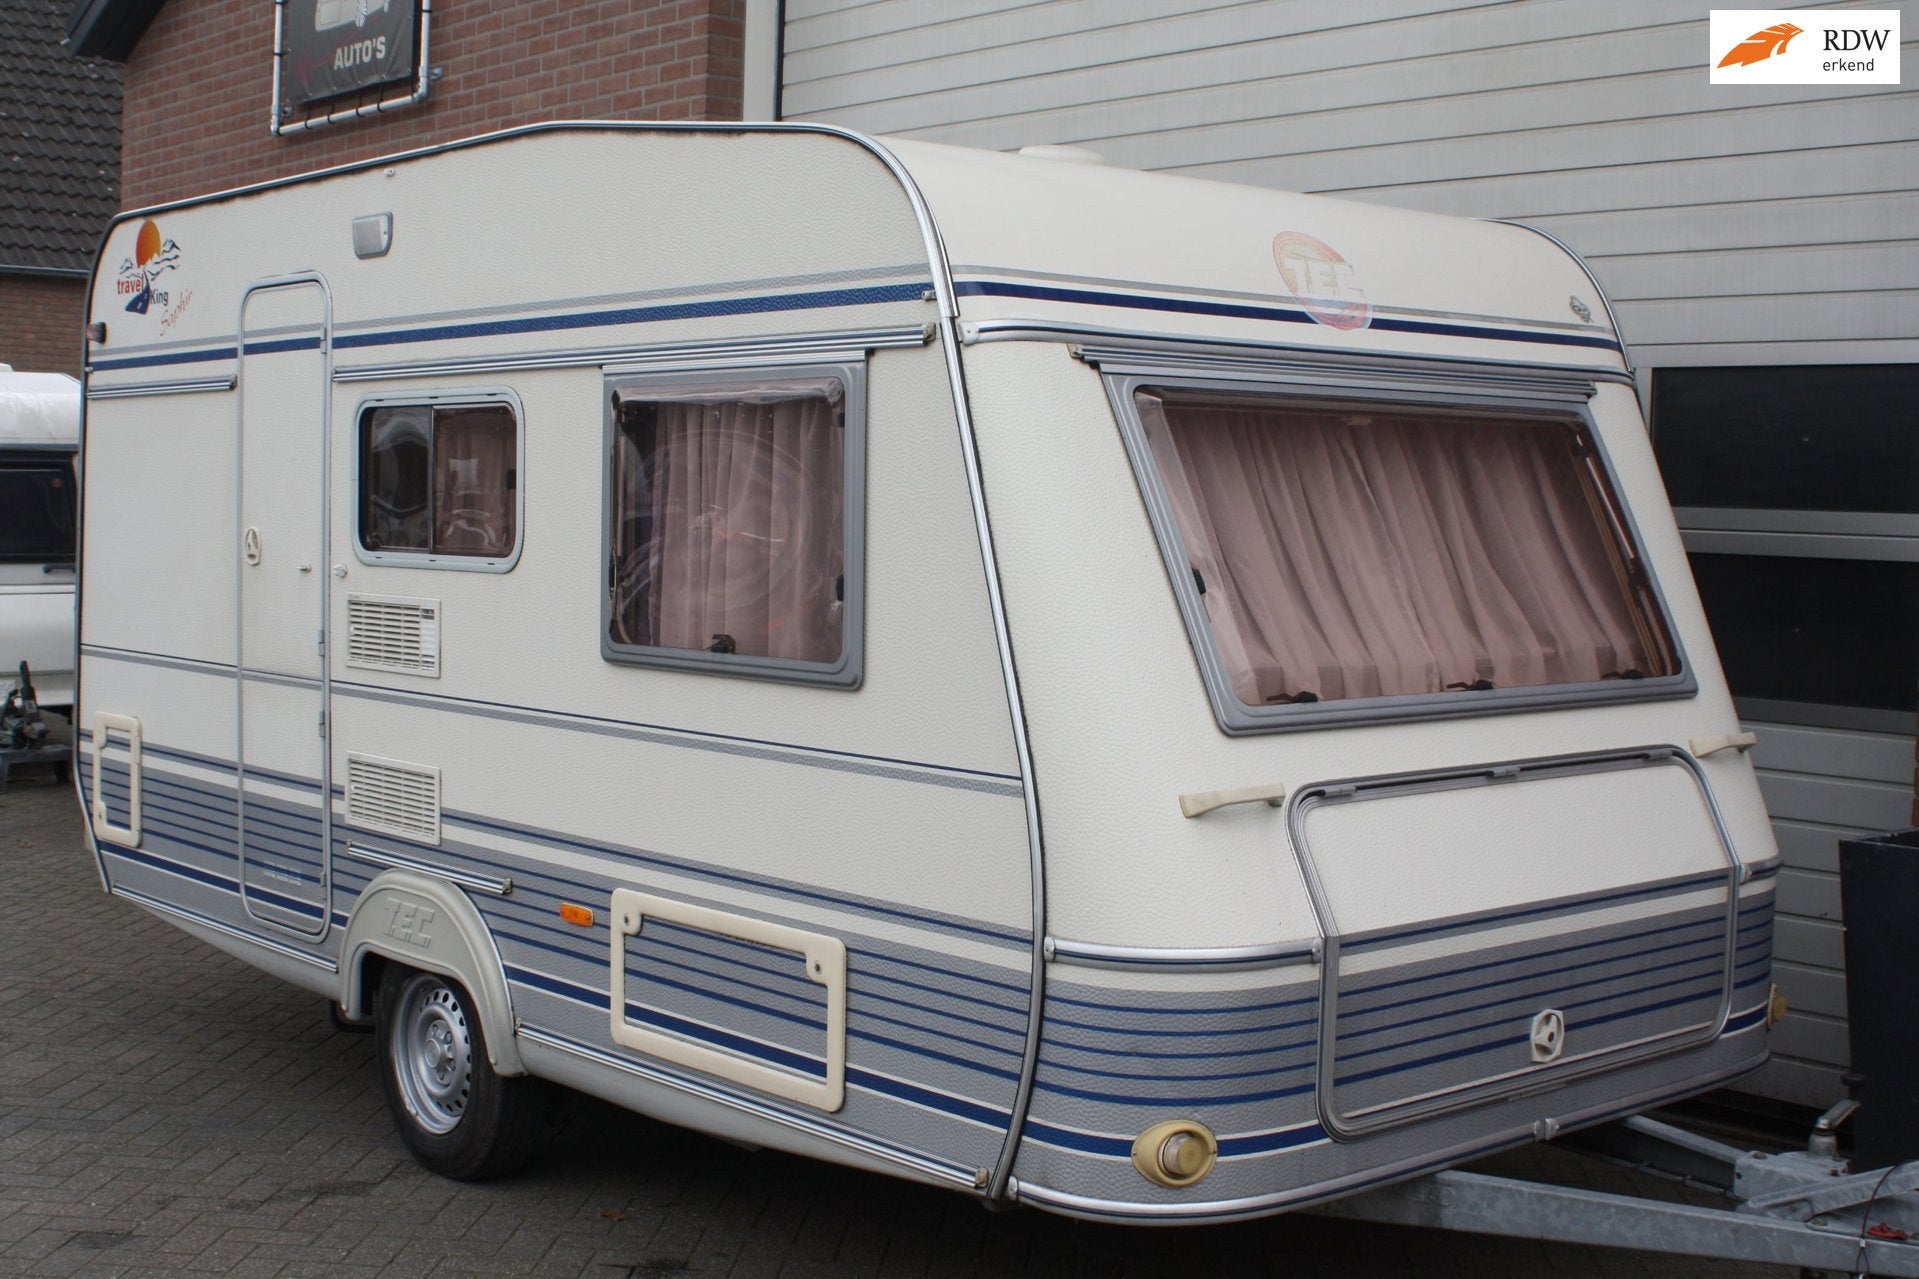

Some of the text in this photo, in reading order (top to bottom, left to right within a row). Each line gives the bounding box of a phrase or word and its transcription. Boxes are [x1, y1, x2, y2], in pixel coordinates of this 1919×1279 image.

[333, 35, 386, 71] AUTO'S
[117, 273, 145, 295] travel
[150, 288, 169, 307] King
[383, 896, 436, 949] TEC
